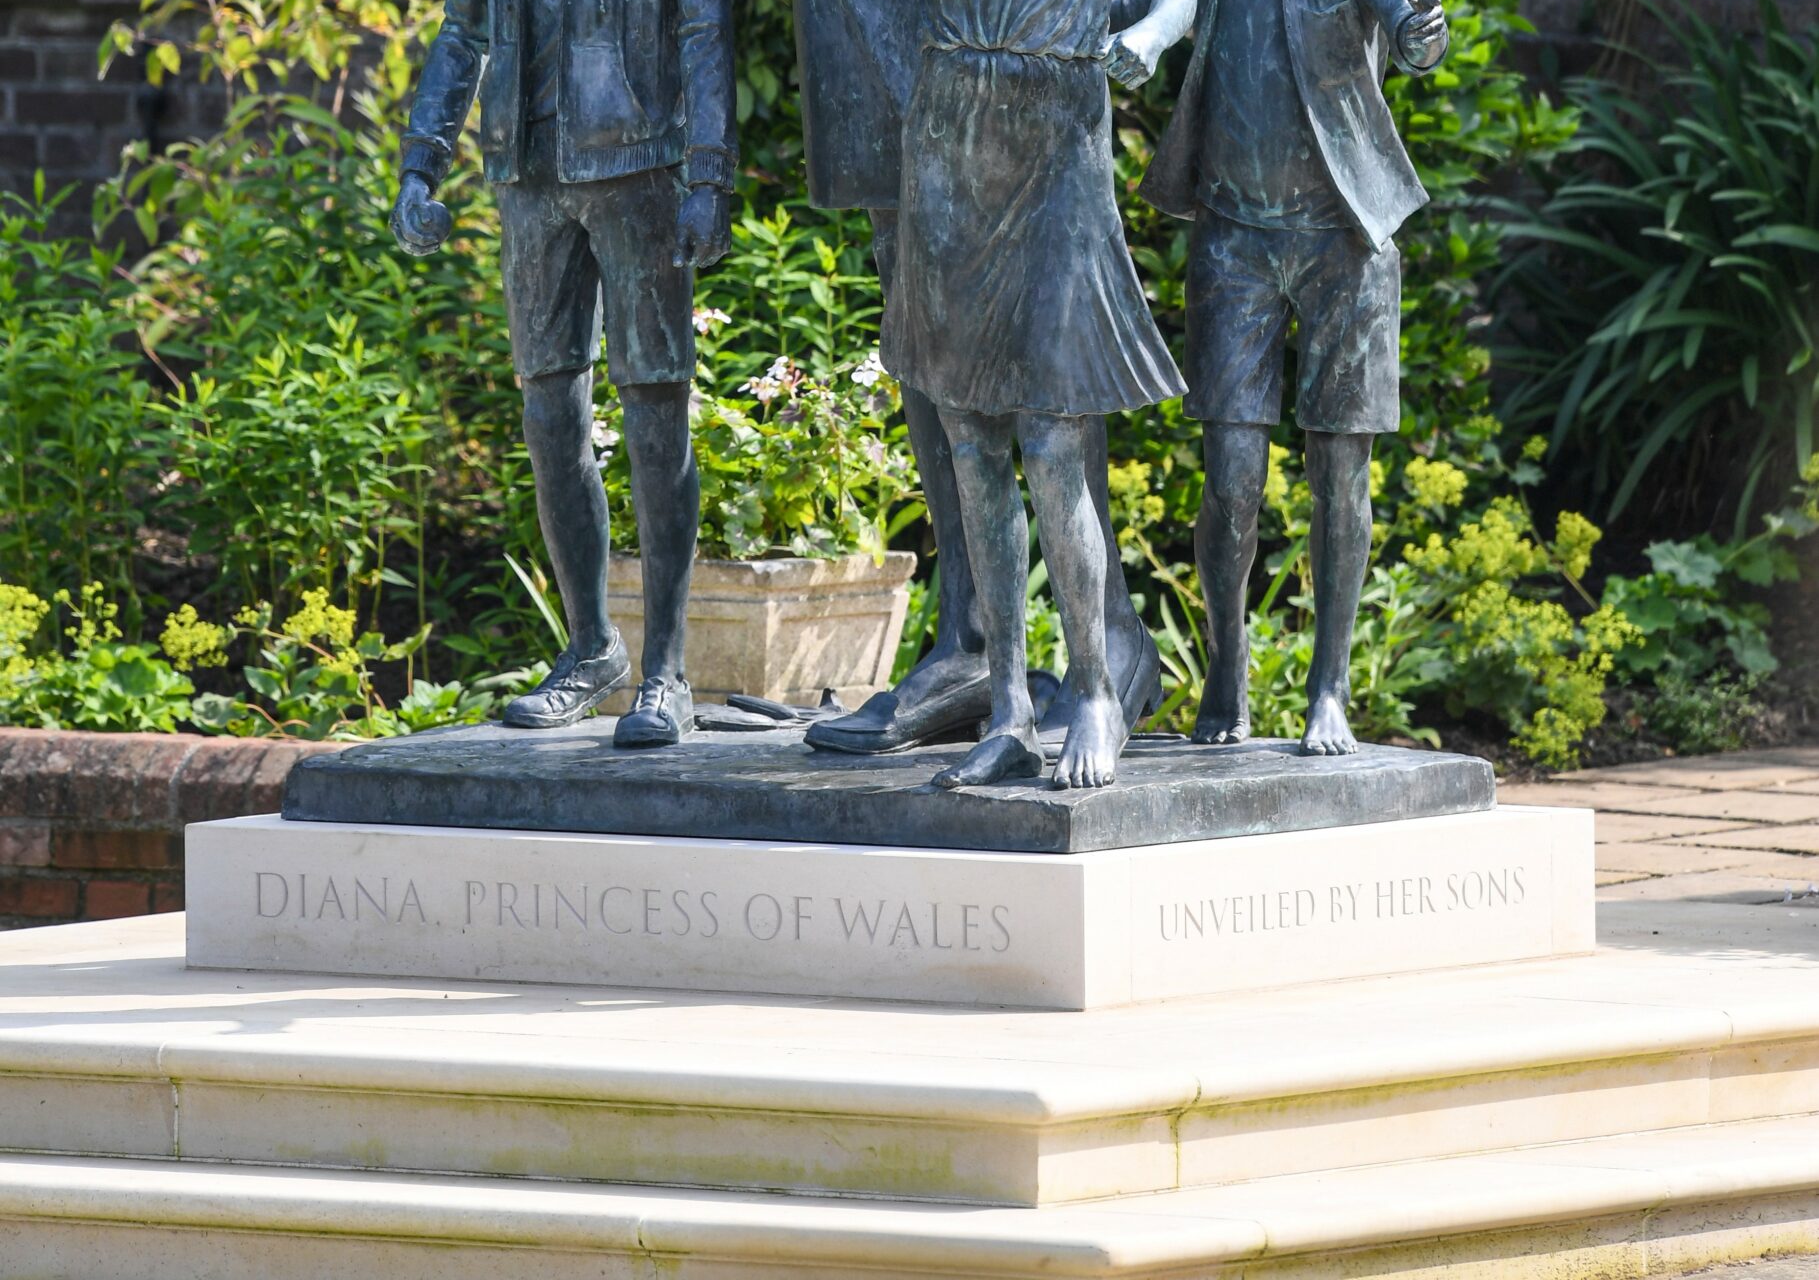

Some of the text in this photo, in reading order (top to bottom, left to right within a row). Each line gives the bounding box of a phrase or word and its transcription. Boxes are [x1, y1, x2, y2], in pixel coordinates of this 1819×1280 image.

[464, 880, 719, 938] PRINCESS
[743, 893, 814, 942] OF
[831, 897, 1011, 953] WALES
[1158, 865, 1526, 942] UNVEILED BY HER SONS
